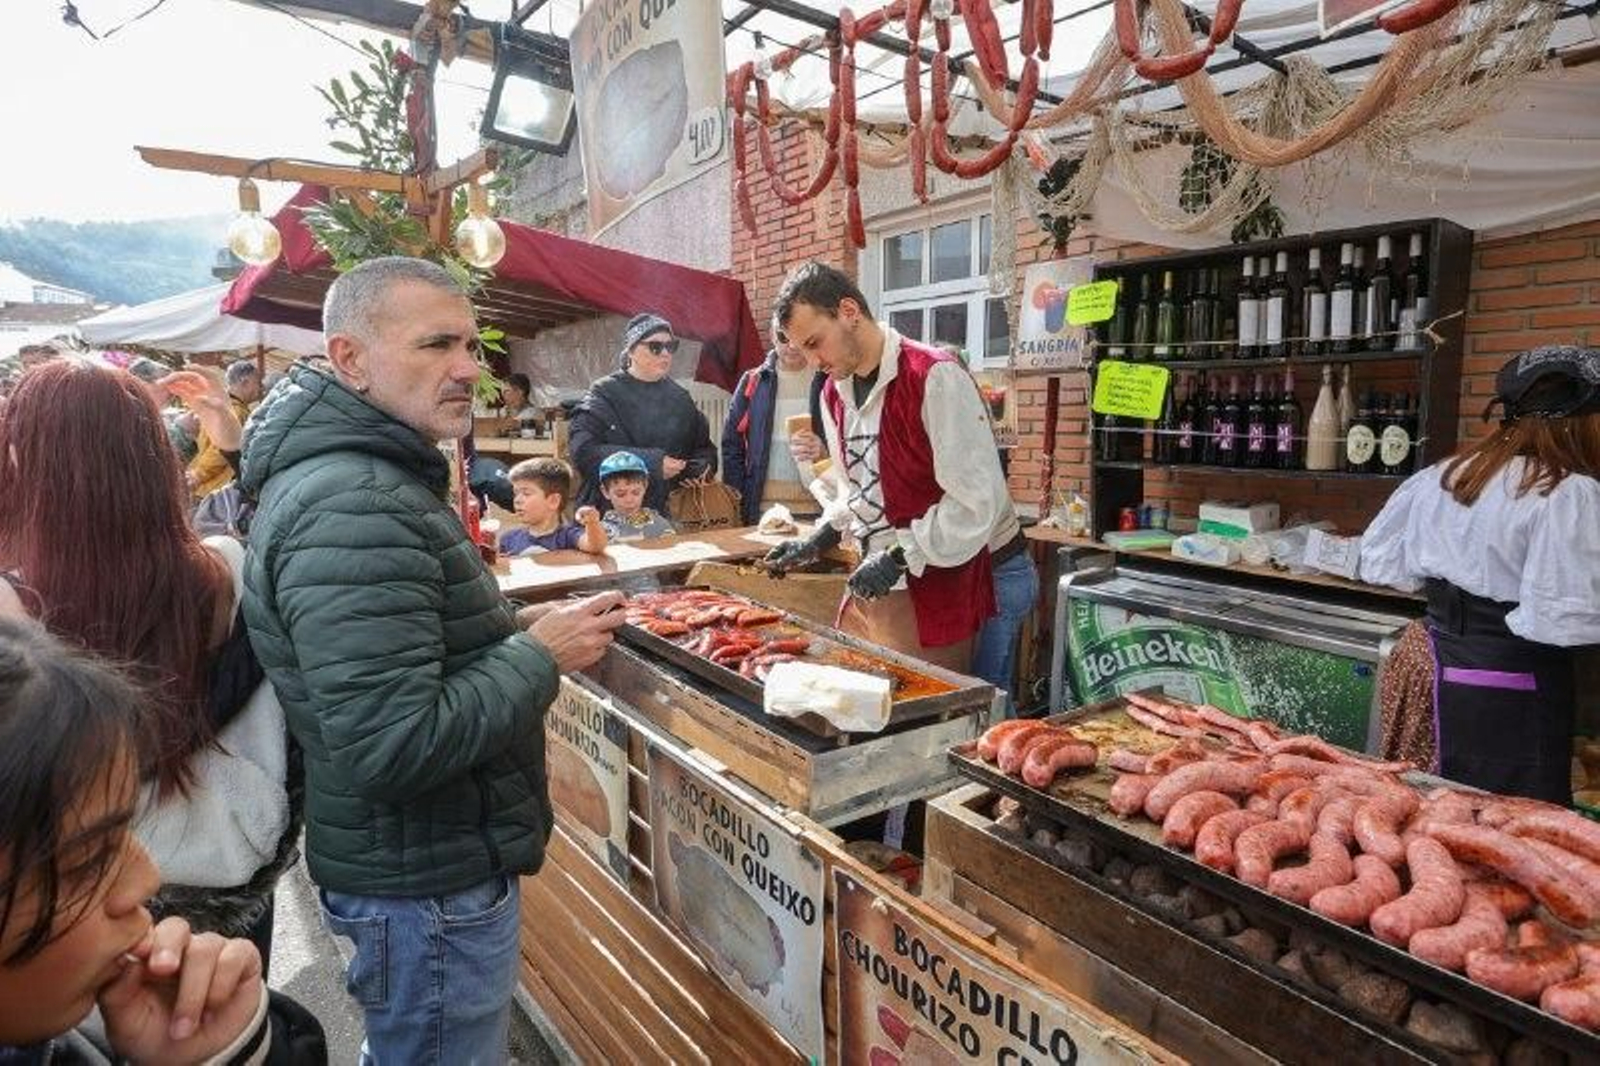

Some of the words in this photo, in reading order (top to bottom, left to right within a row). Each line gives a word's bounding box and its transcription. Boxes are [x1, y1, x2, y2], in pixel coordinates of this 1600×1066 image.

[1081, 633, 1226, 686] Heineken
[678, 776, 770, 859] BOCADILLO
[703, 823, 735, 866] CON
[741, 853, 816, 926] QUEIXO
[841, 931, 980, 1058] CHOURIZO
[893, 922, 1078, 1066] BOCADILLO
